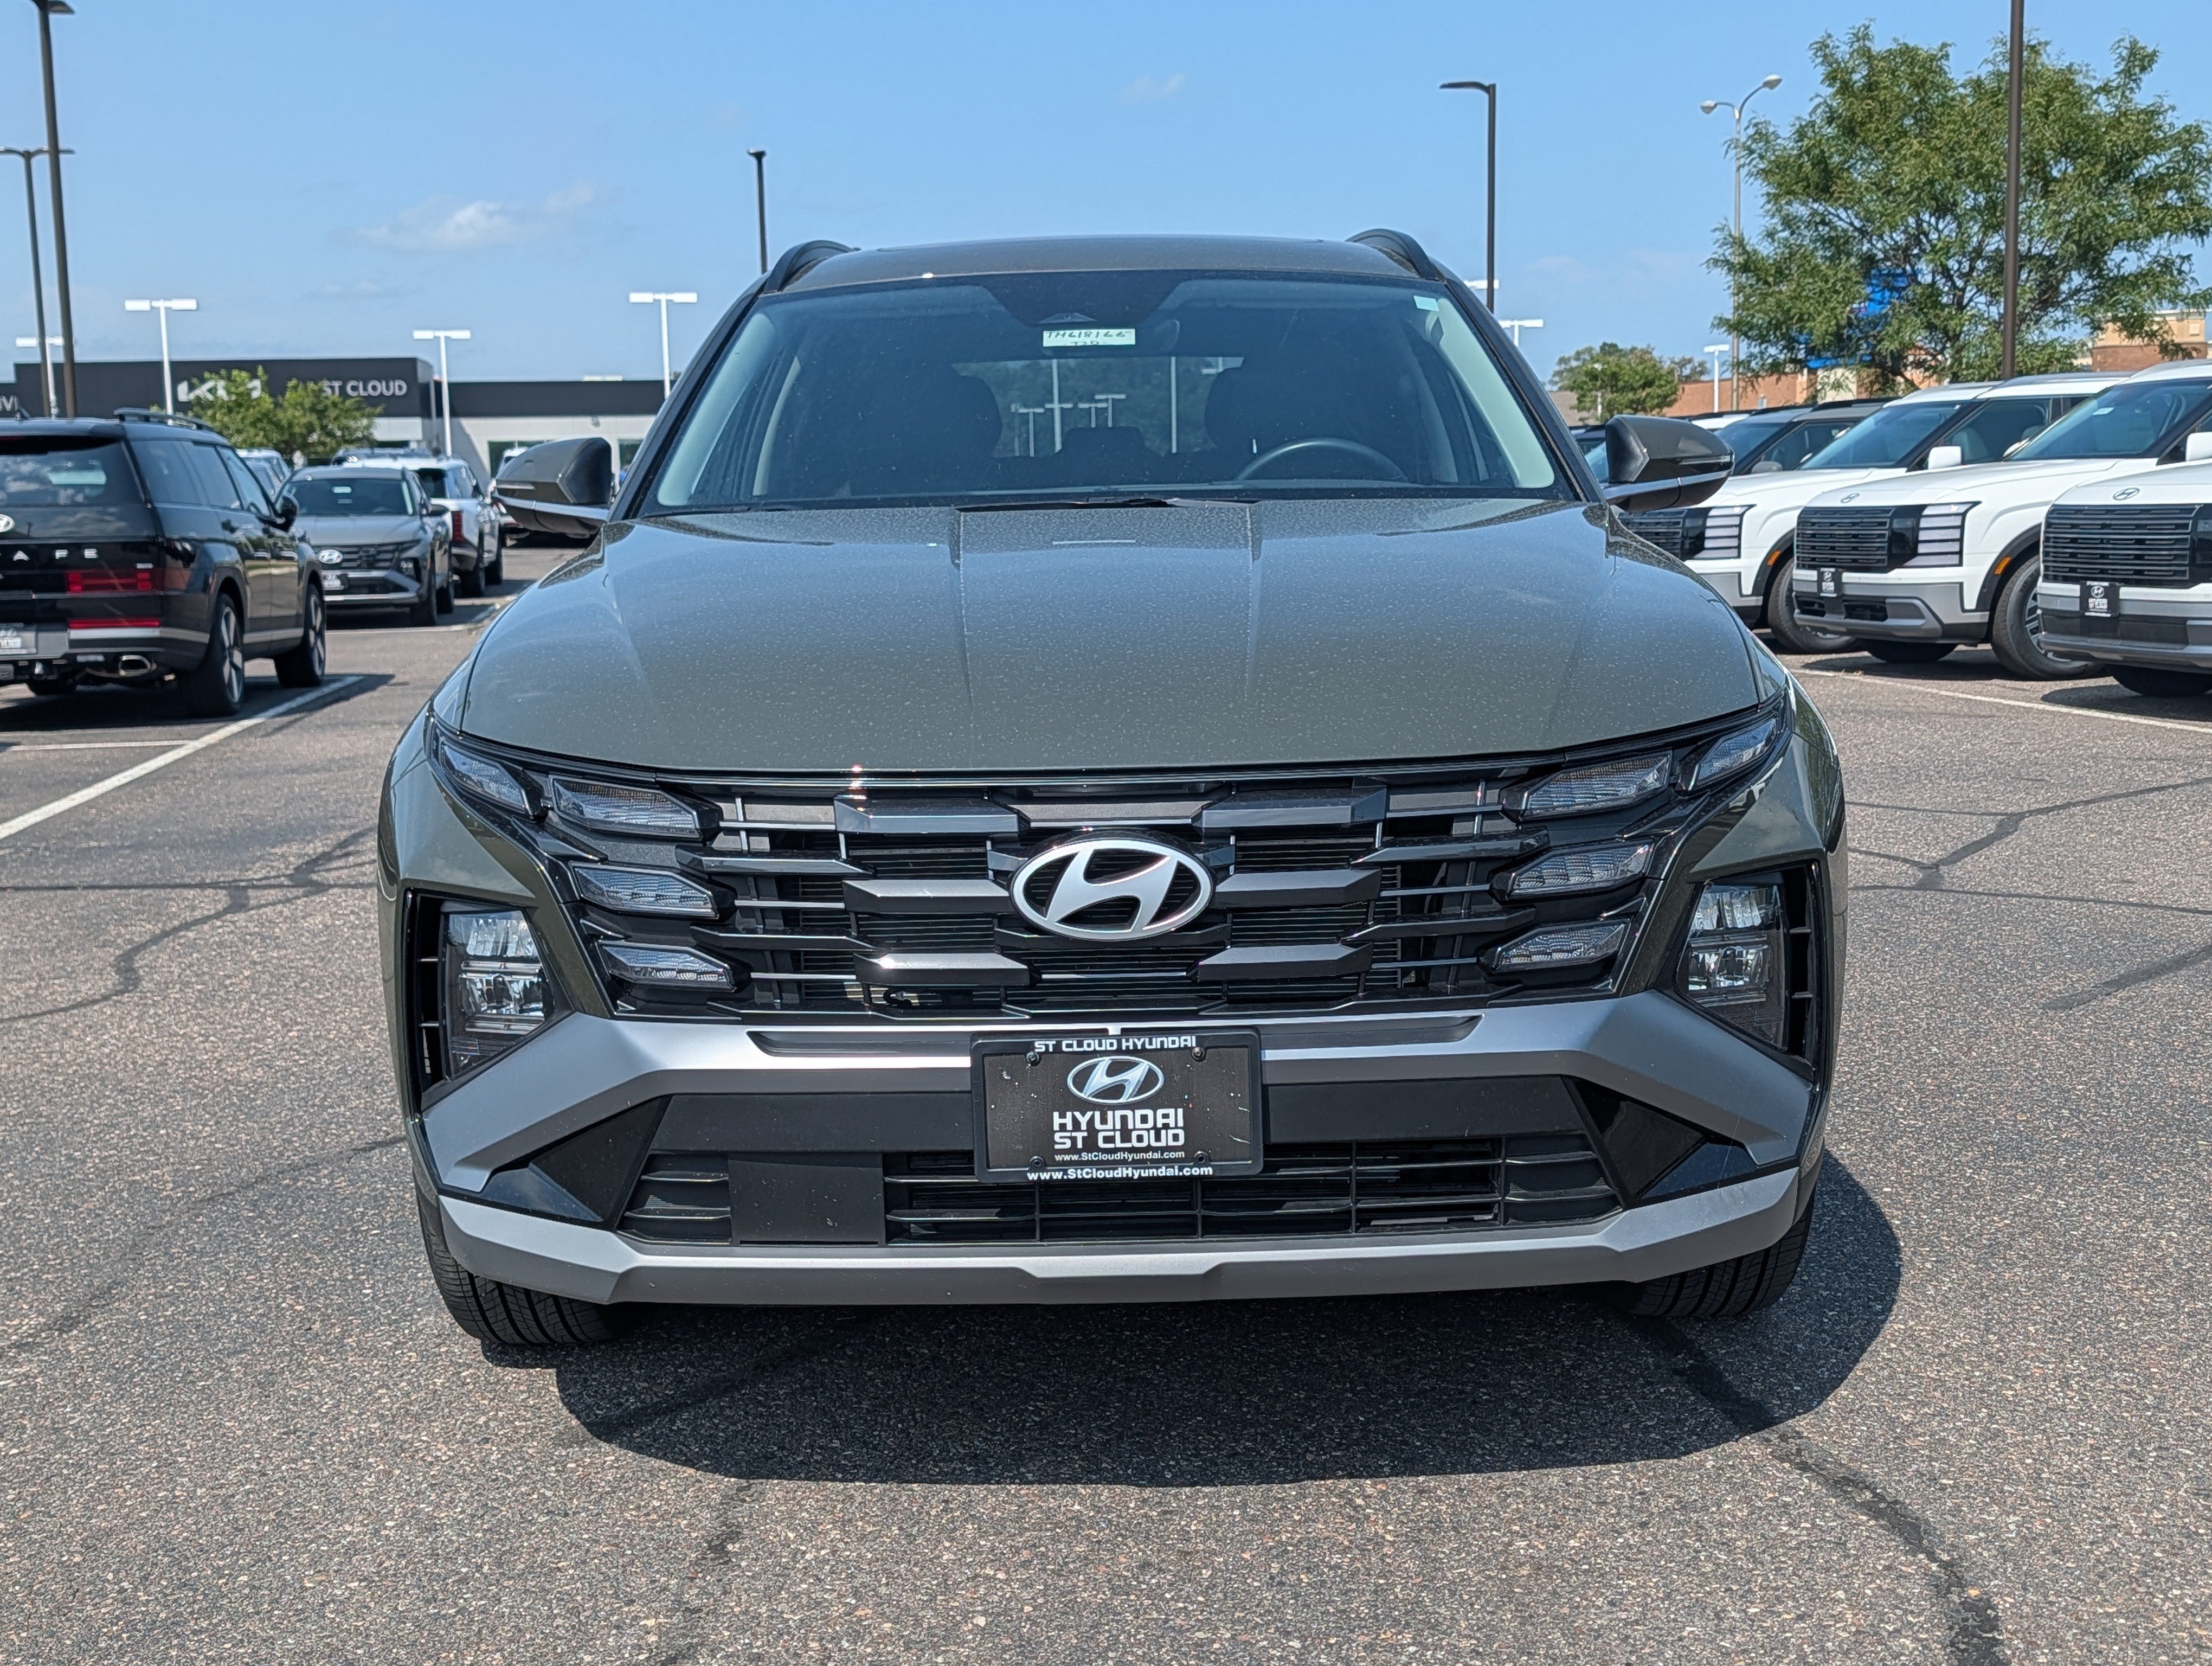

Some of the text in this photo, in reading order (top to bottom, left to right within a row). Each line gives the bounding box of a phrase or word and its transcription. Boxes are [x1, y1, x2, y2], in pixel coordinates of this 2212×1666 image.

[323, 380, 407, 396] ST CLOUD
[1034, 1035, 1197, 1053] ST CLOUD HYUNDAI
[1053, 1107, 1184, 1131] HYUNDAI
[1054, 1129, 1185, 1149] ST CLOUD
[1054, 1150, 1185, 1162] www.StCloudHyundai.com
[1027, 1165, 1213, 1181] www.StCloudHyundai.com
